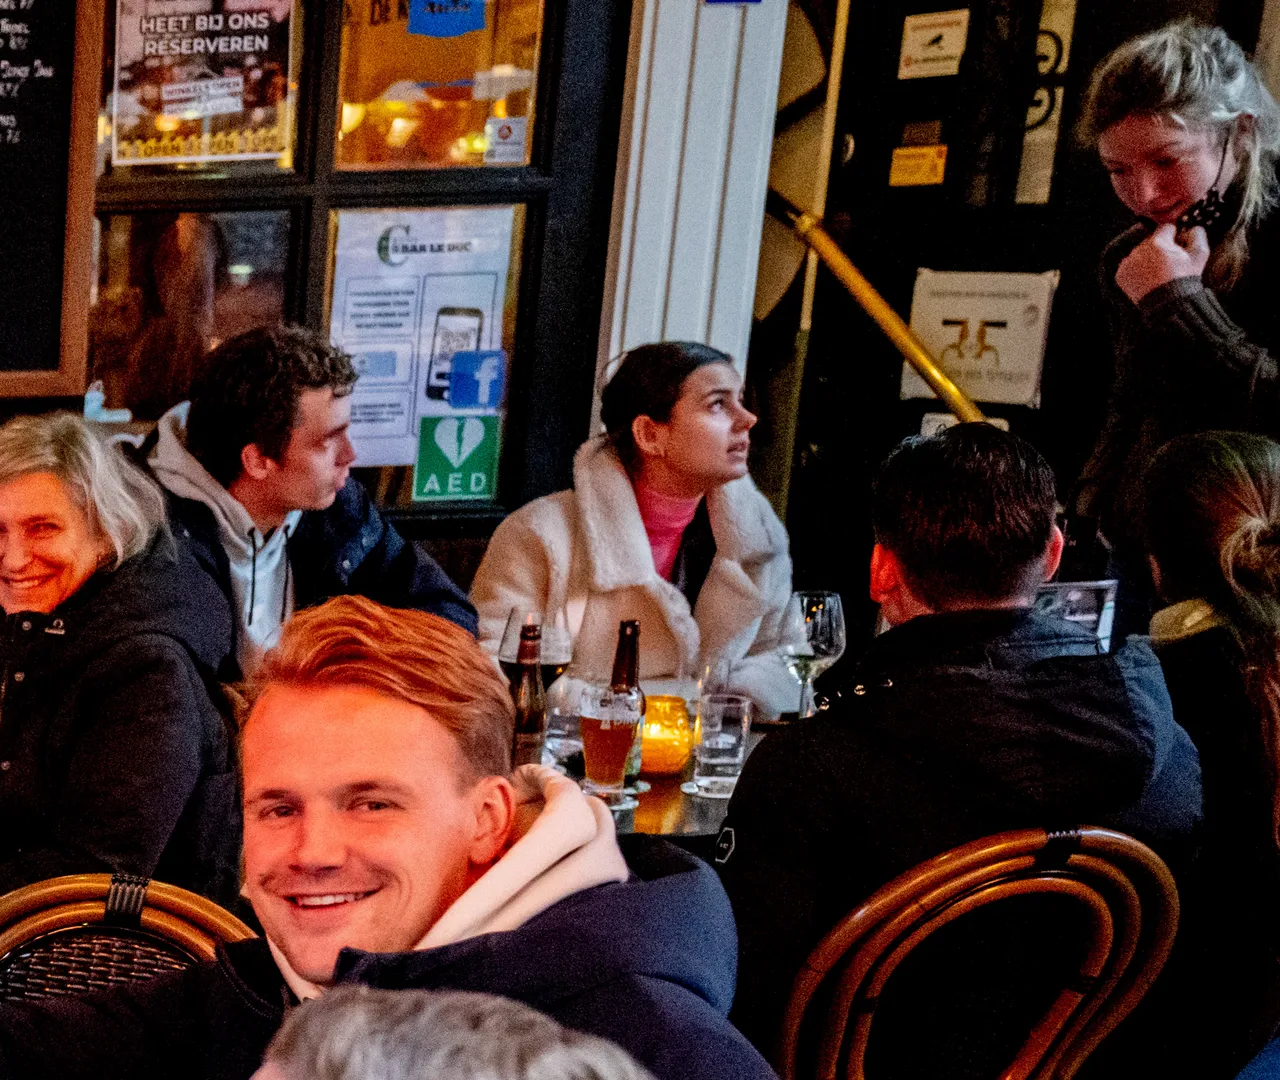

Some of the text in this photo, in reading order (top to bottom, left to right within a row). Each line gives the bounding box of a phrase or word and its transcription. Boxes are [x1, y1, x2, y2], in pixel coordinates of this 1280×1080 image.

[141, 13, 269, 33] HEET BIJ ONS
[144, 35, 269, 55] RESERVEREN
[423, 472, 487, 494] AED
